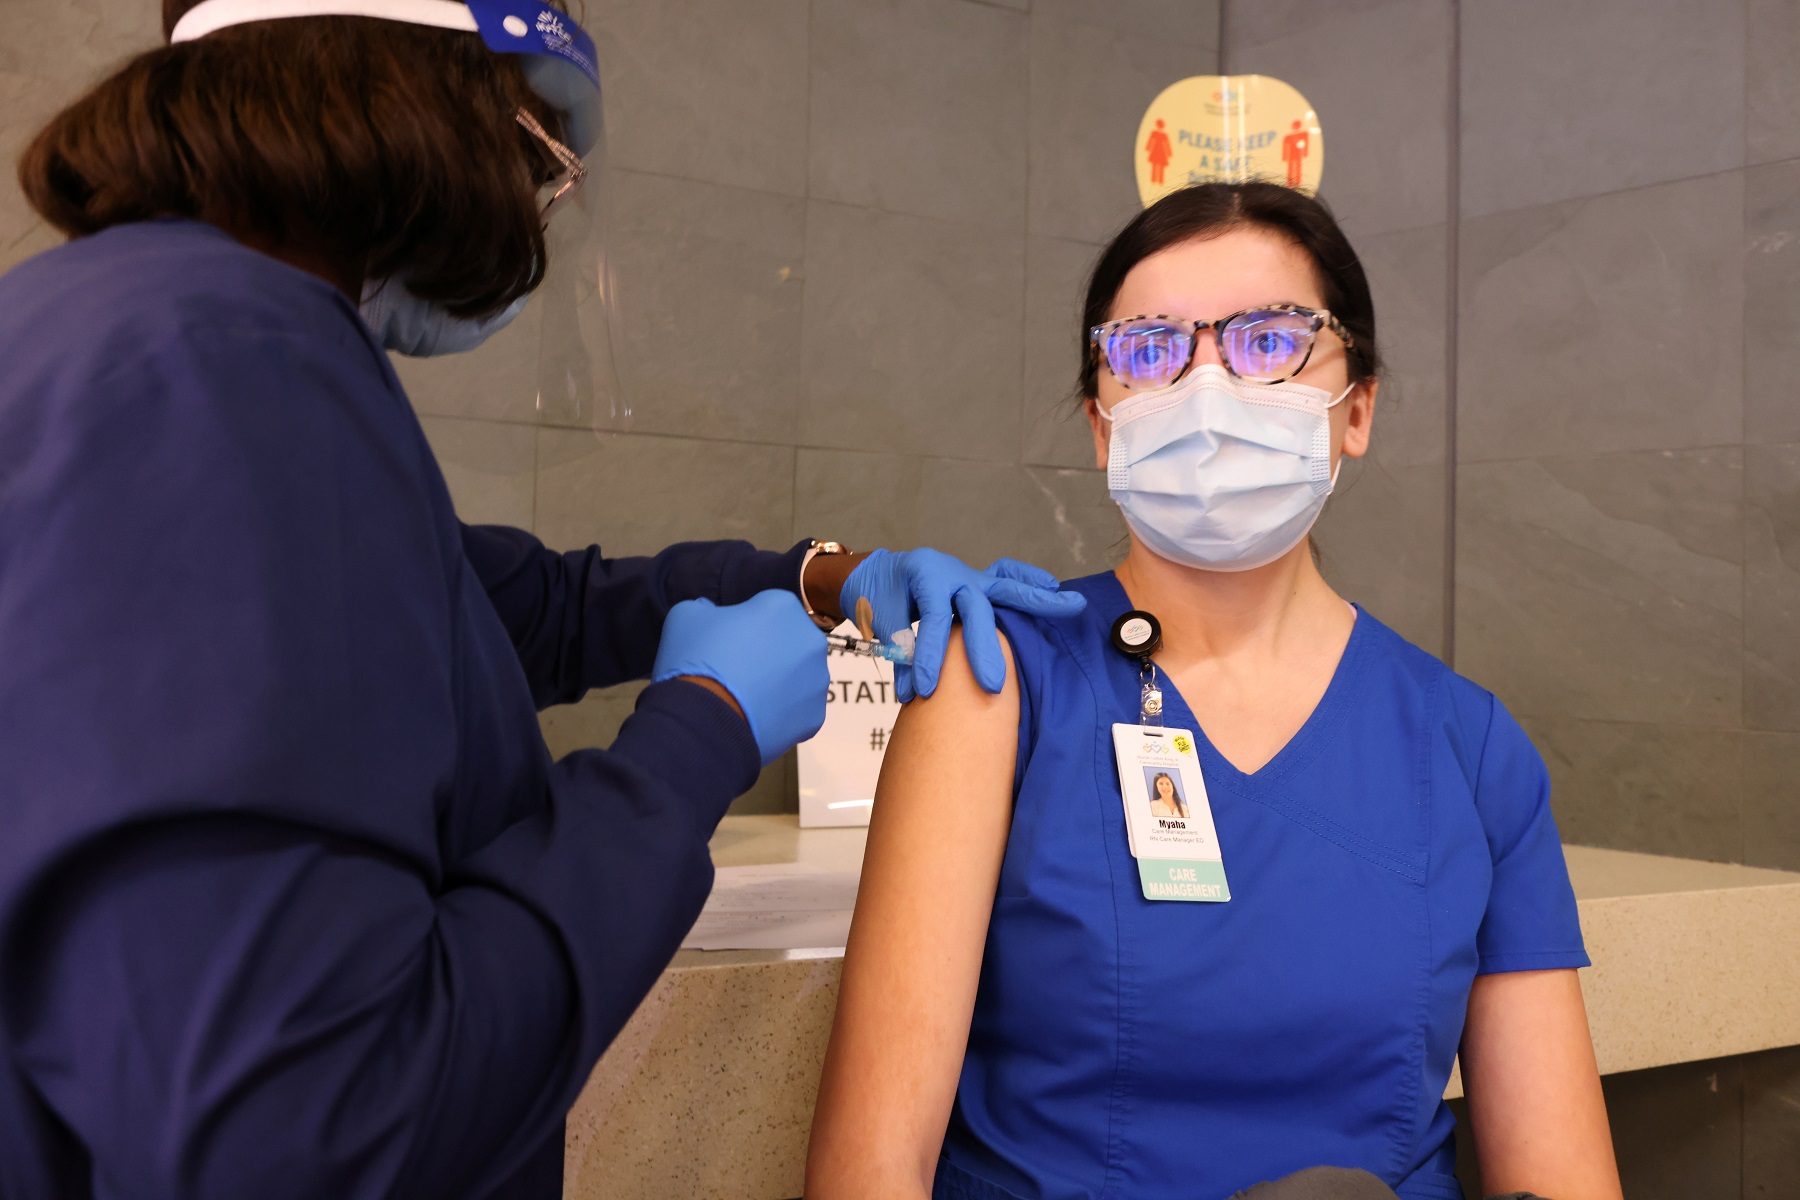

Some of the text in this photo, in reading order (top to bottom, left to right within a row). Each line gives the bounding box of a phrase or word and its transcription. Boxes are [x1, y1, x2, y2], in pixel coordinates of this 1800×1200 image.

[1200, 154, 1209, 169] A
[1158, 819, 1186, 829] Myaha
[1168, 868, 1197, 882] CARE
[1149, 882, 1221, 898] MANAGEMENT
